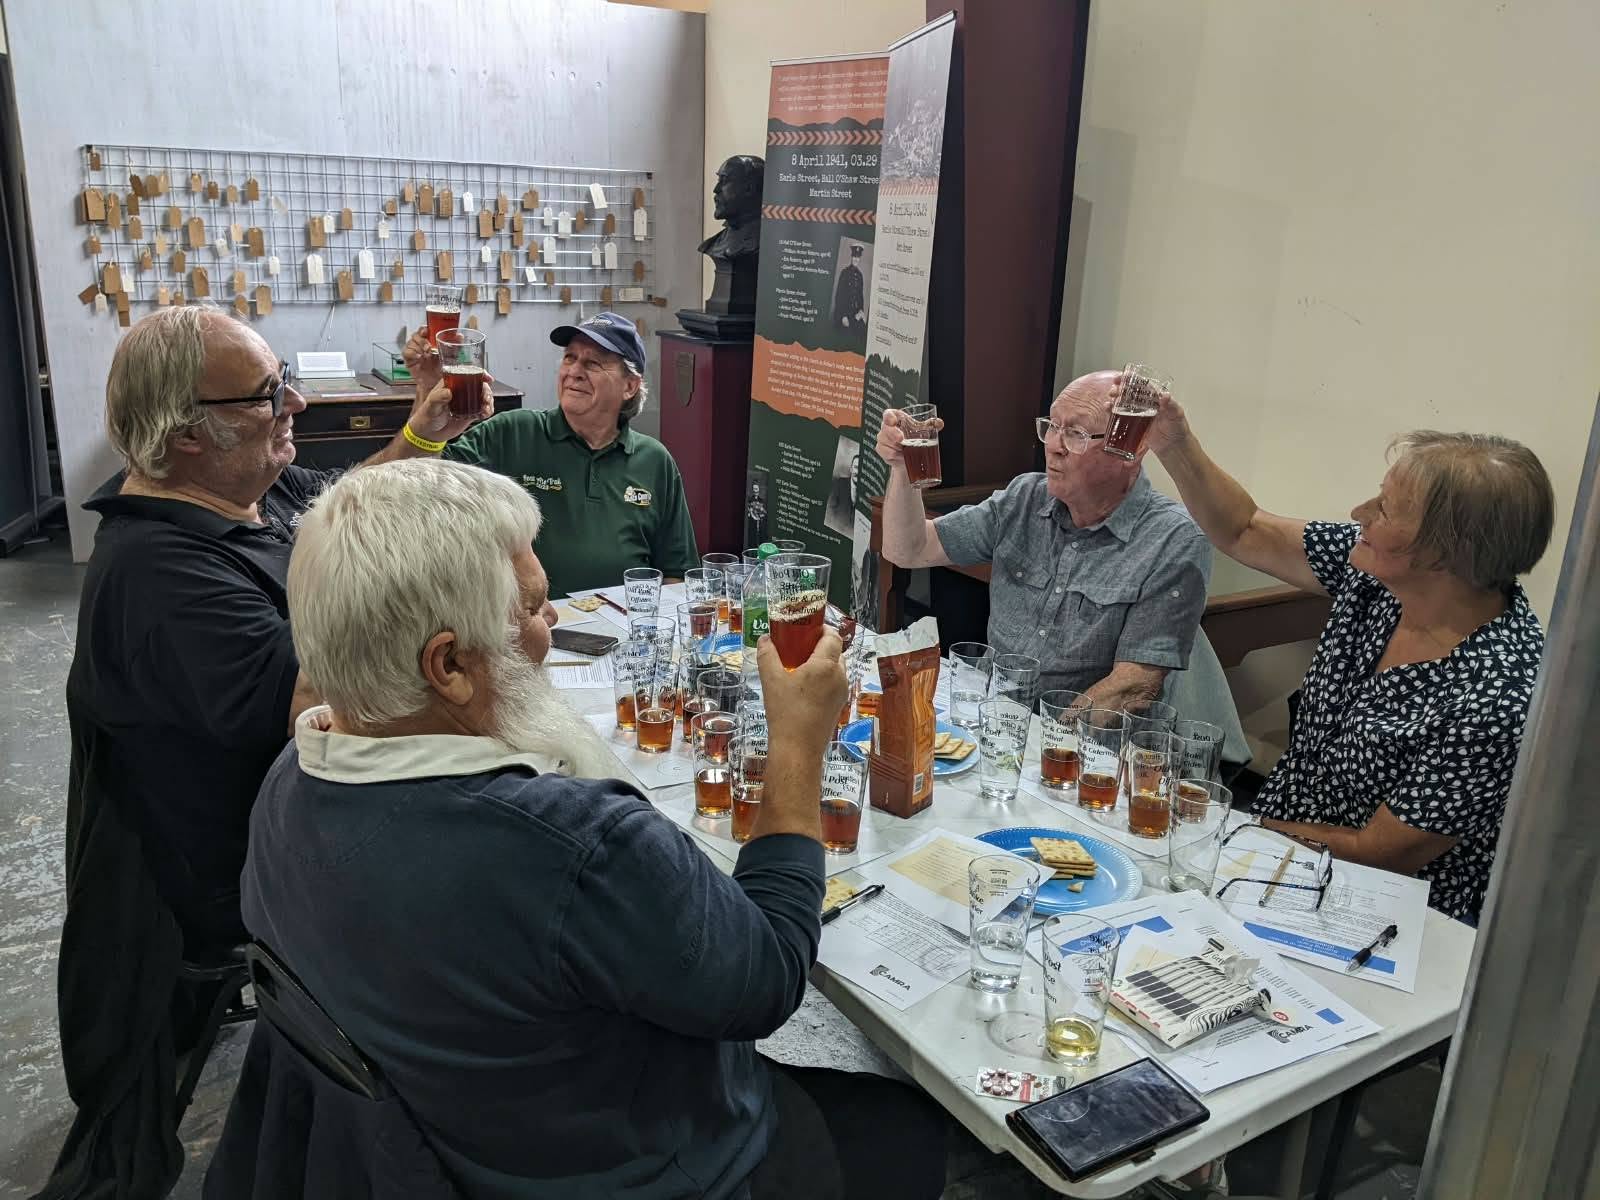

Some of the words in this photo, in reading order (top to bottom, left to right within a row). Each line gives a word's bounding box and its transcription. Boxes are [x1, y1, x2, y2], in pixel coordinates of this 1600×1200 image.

[791, 153, 797, 166] 8
[799, 154, 824, 168] April
[826, 154, 848, 168] 1941,
[850, 154, 878, 166] 03.29
[779, 173, 796, 182] Earle
[797, 174, 820, 184] Street,
[821, 174, 835, 183] Hall
[859, 175, 881, 184] Stree
[809, 188, 831, 197] Martin
[831, 189, 852, 198] Street
[802, 595, 808, 603] &
[878, 970, 911, 991] CAMRA
[1278, 1023, 1315, 1040] CAMRA
